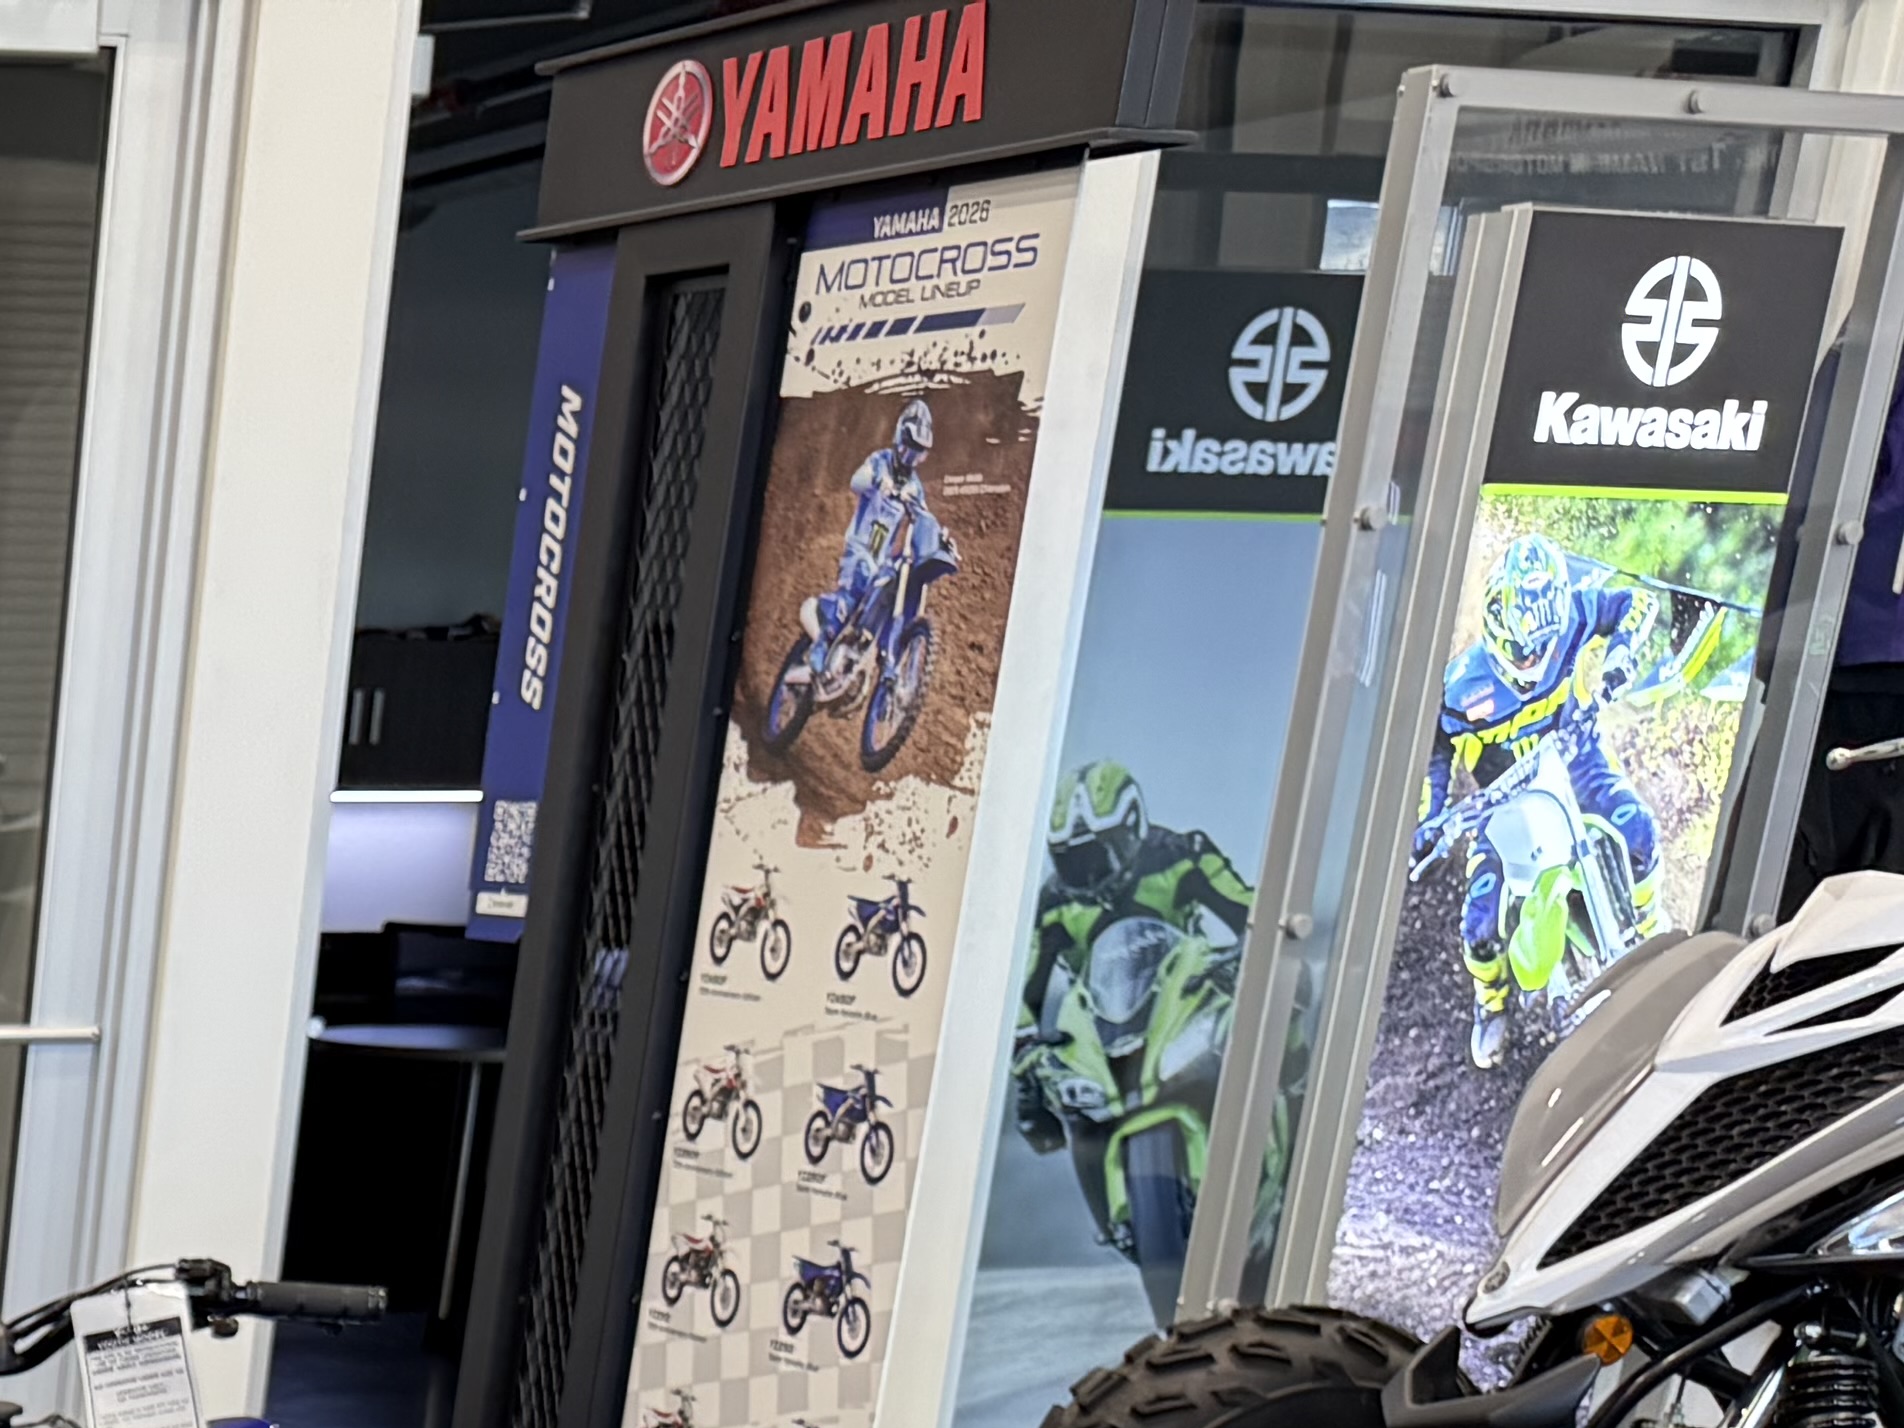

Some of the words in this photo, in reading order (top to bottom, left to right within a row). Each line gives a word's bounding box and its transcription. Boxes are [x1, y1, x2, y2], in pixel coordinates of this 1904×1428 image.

[718, 0, 987, 168] YAMAHA
[872, 206, 940, 238] YAMAHA
[947, 199, 991, 228] 2026
[814, 233, 1040, 296] MOTOCROSS
[859, 287, 915, 311] MODEL
[920, 278, 981, 302] LINEUP
[1533, 391, 1769, 452] Kawasaki
[519, 383, 584, 711] MOTOCROSS
